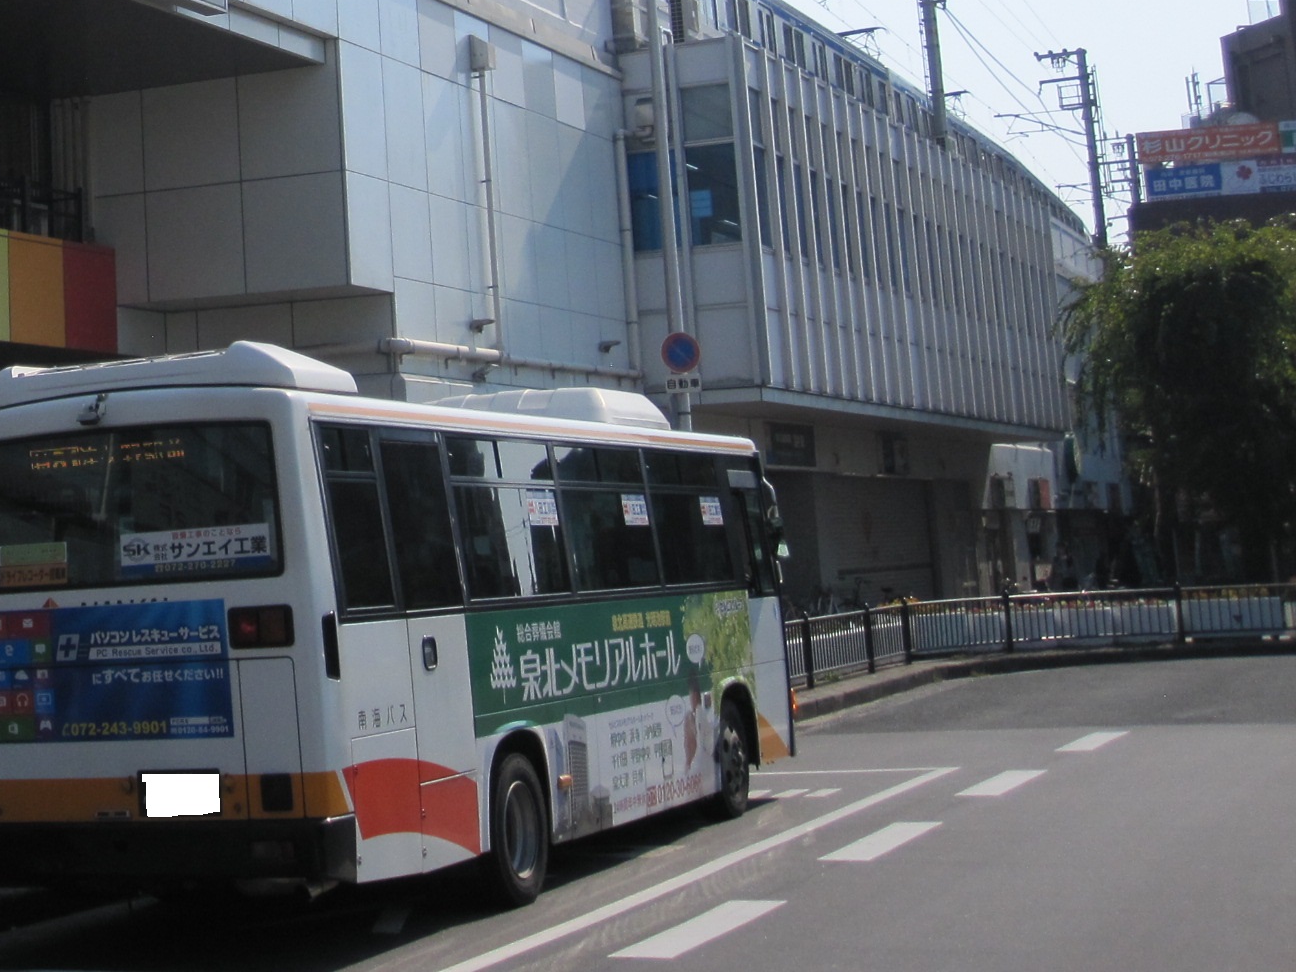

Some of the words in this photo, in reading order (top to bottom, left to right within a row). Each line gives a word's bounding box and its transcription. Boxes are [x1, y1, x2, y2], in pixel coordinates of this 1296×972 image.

[1142, 131, 1273, 154] 杉山クリニック
[170, 536, 268, 559] サンエイ工業
[90, 630, 129, 645] パソコン
[132, 626, 220, 643] レスキューサービス
[96, 648, 108, 658] PC
[112, 647, 141, 657] Rescue
[145, 645, 179, 656] Service
[520, 630, 681, 701] 泉北メモリアルホール
